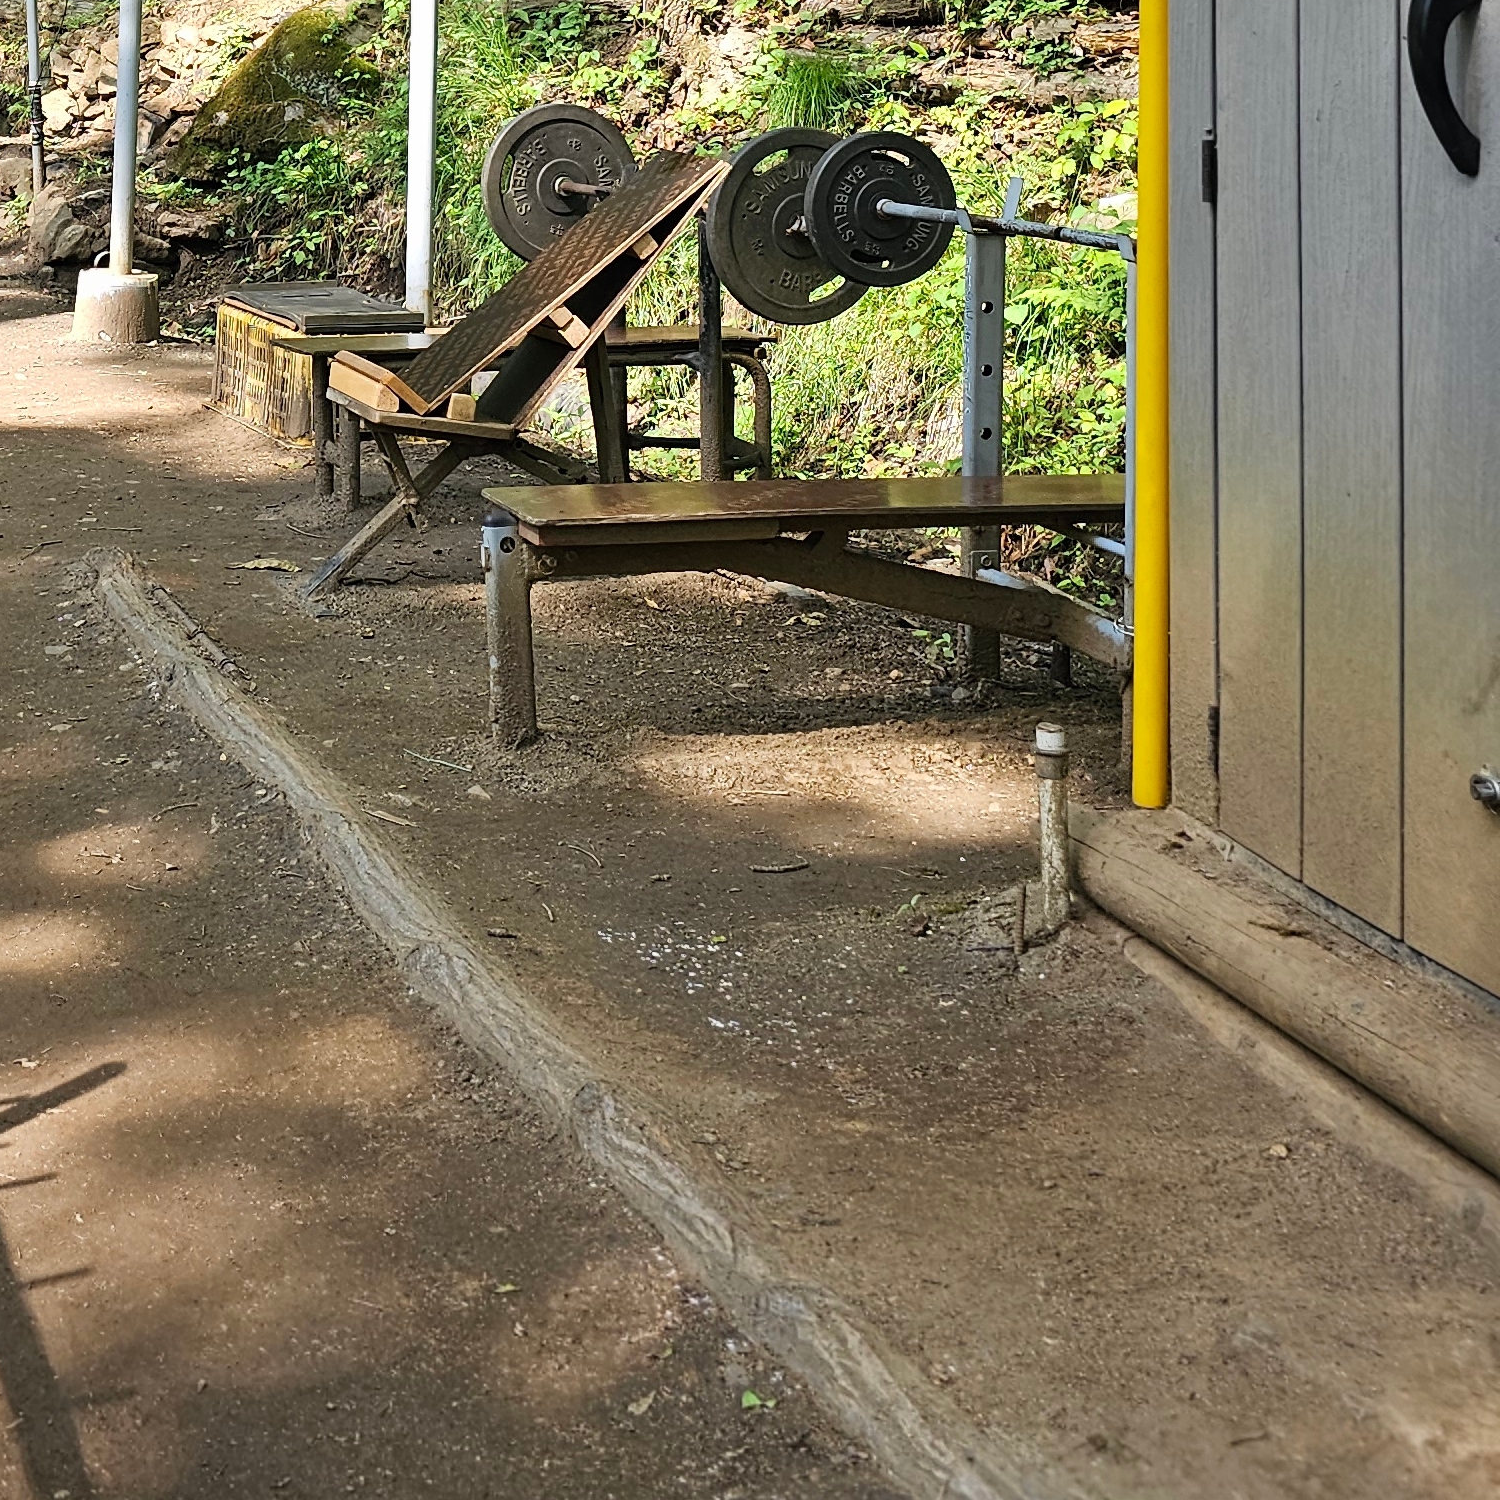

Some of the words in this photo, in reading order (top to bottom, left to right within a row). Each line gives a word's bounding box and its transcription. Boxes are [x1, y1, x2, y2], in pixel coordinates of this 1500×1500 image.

[744, 160, 813, 216] SAMSUN
[833, 164, 867, 242] BARBELLS
[906, 173, 936, 251] SAMUNG
